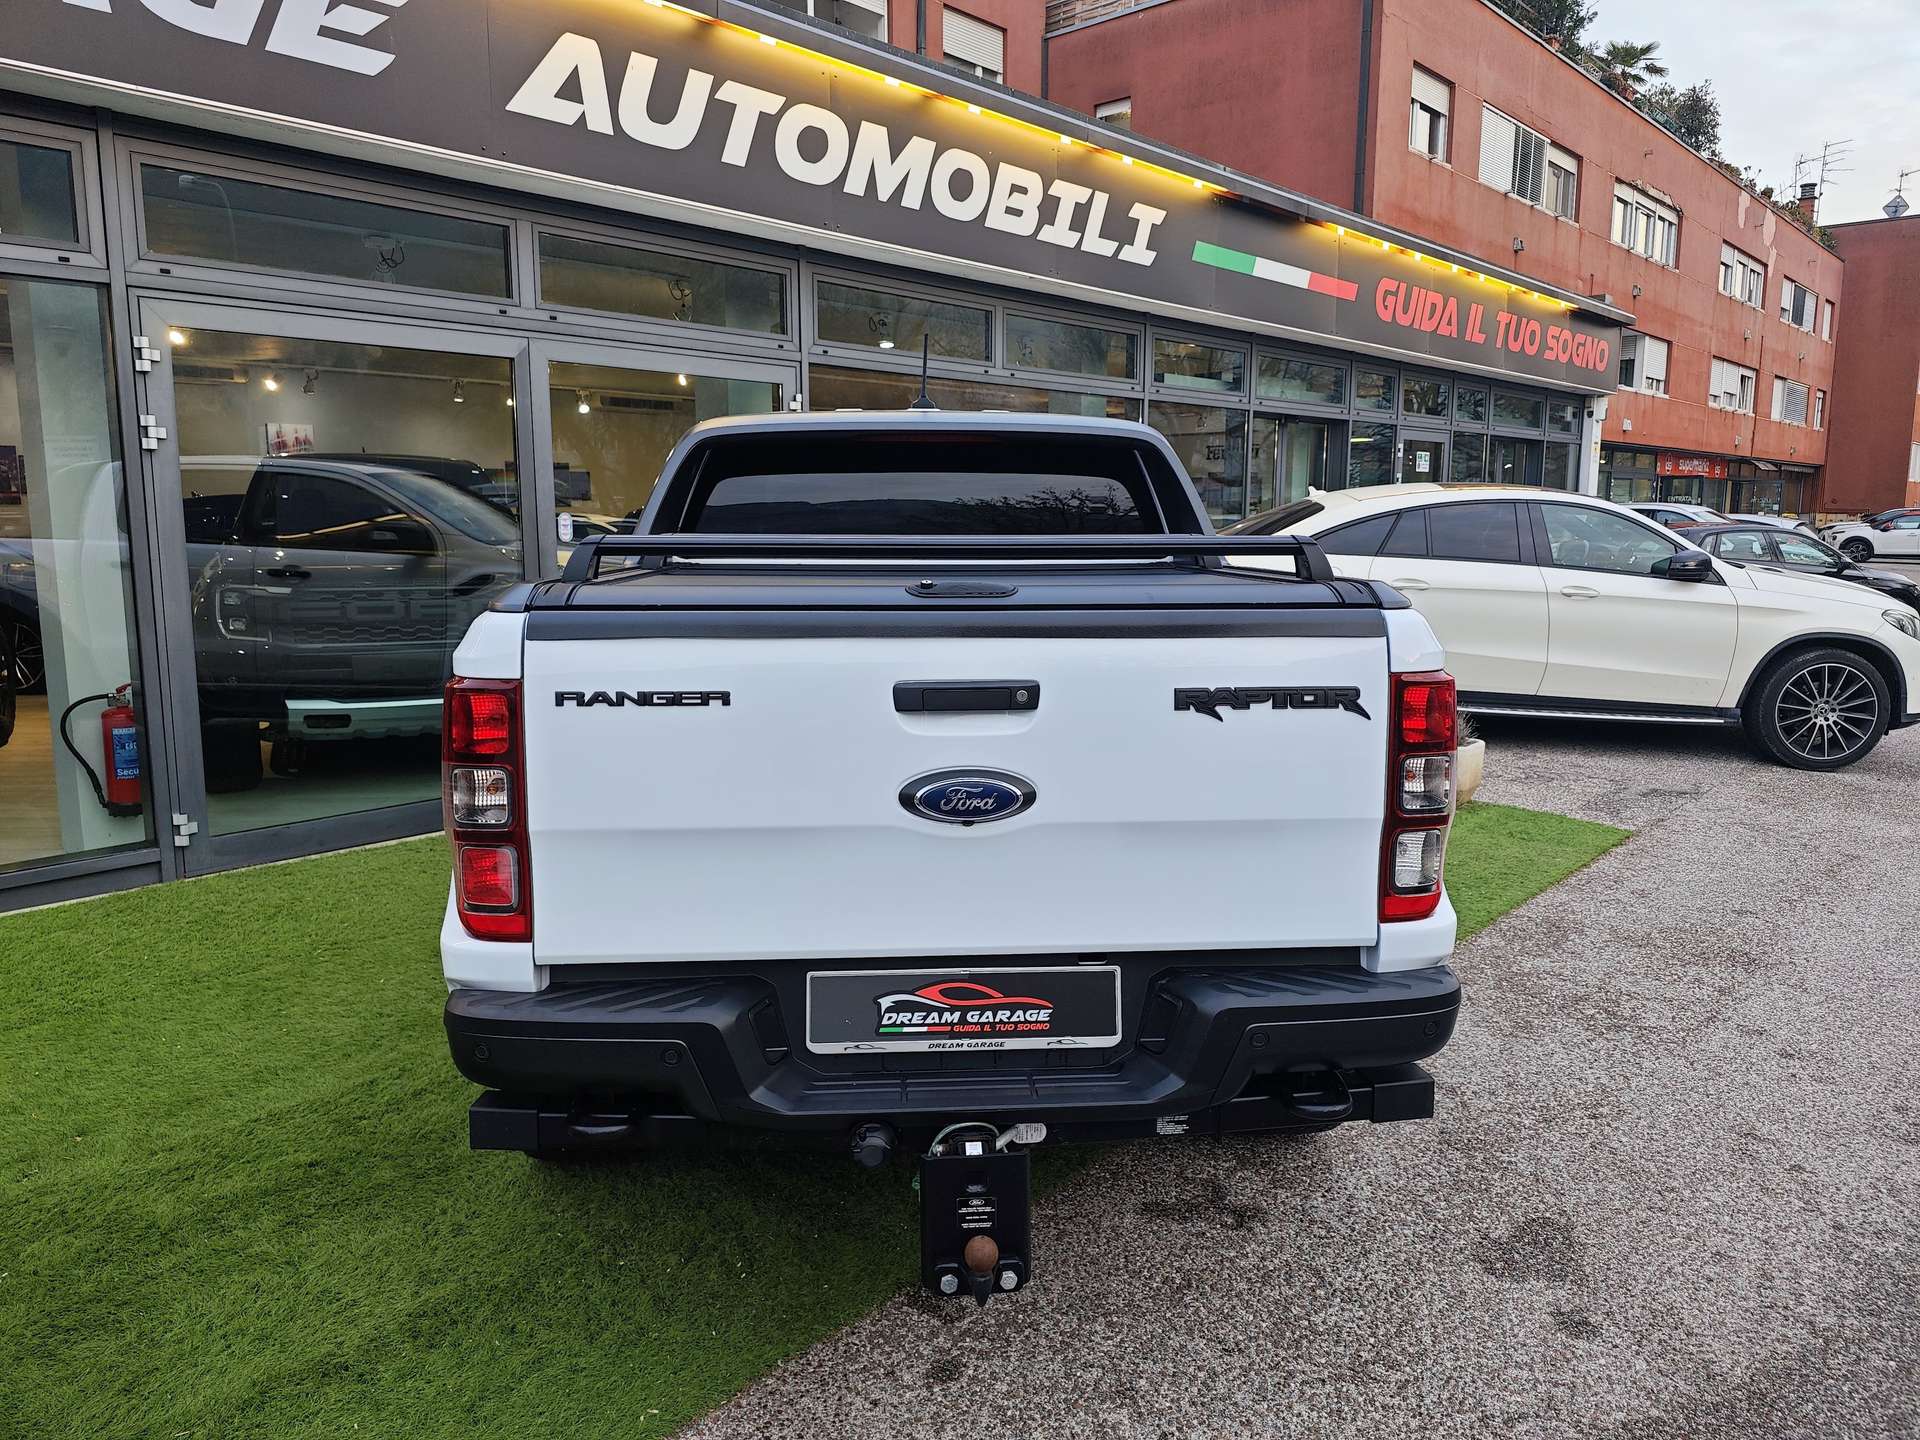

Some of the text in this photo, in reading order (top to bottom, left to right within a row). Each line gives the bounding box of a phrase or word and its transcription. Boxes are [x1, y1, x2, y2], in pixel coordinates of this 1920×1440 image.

[506, 32, 1167, 267] AUTOMOBILI
[1375, 277, 1609, 372] GUIDA IL TUO SOGNO
[554, 690, 731, 708] RANGER
[1174, 686, 1372, 722] RAPTOR
[939, 786, 998, 812] Ford
[881, 1009, 1054, 1025] DREAM GARAGE
[952, 1022, 1050, 1033] GUIDA IL TUO SOGNO
[928, 1040, 1006, 1050] DREAM GARAGE
